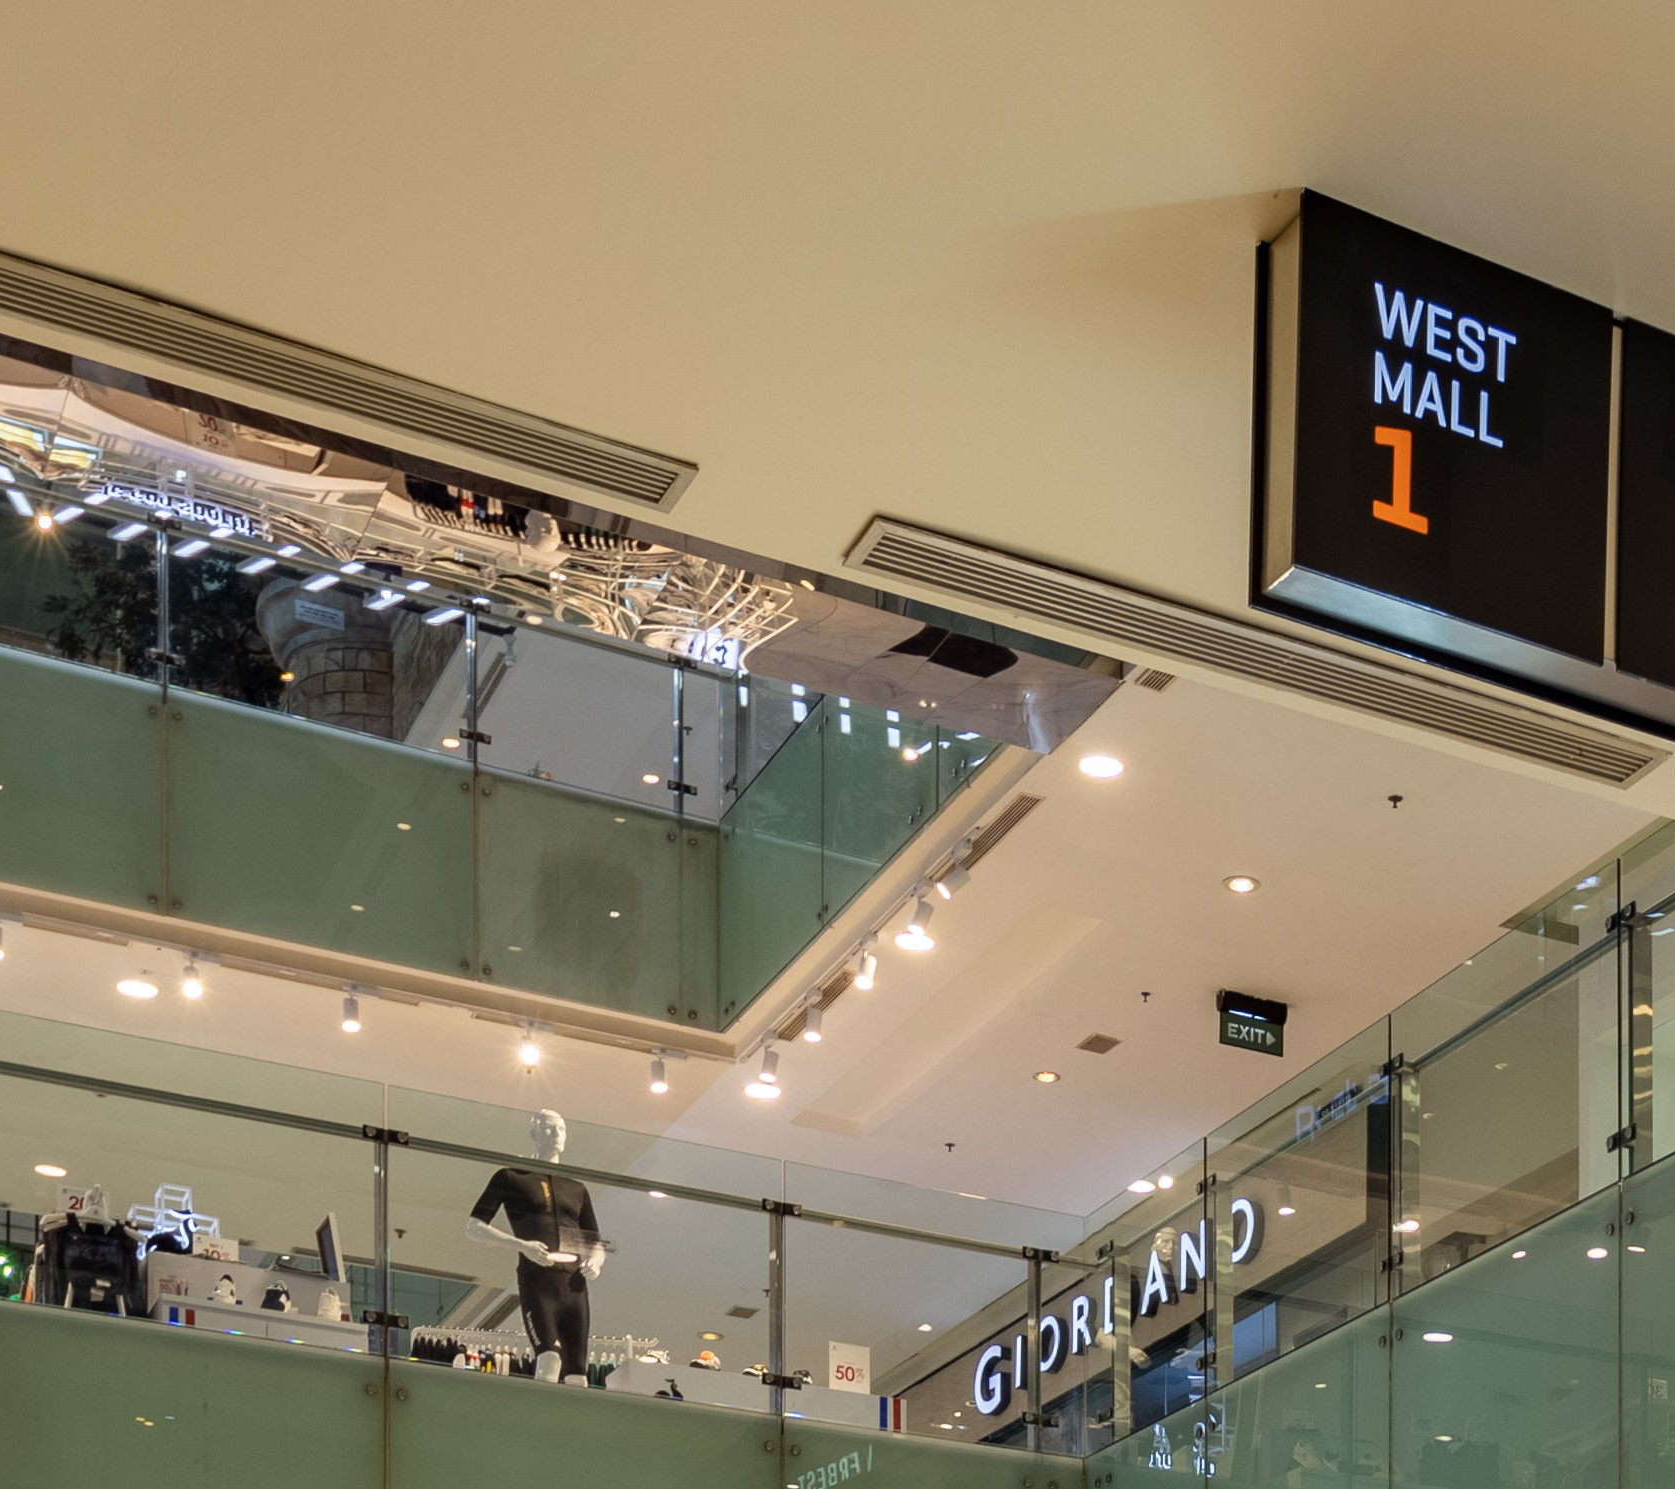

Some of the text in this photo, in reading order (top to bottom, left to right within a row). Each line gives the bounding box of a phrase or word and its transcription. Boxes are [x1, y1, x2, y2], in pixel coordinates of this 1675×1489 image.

[1374, 279, 1517, 383] WEST
[1373, 350, 1504, 449] MALL
[1372, 425, 1429, 535] 1
[1226, 1021, 1266, 1045] EXIT
[834, 1364, 865, 1383] 50%
